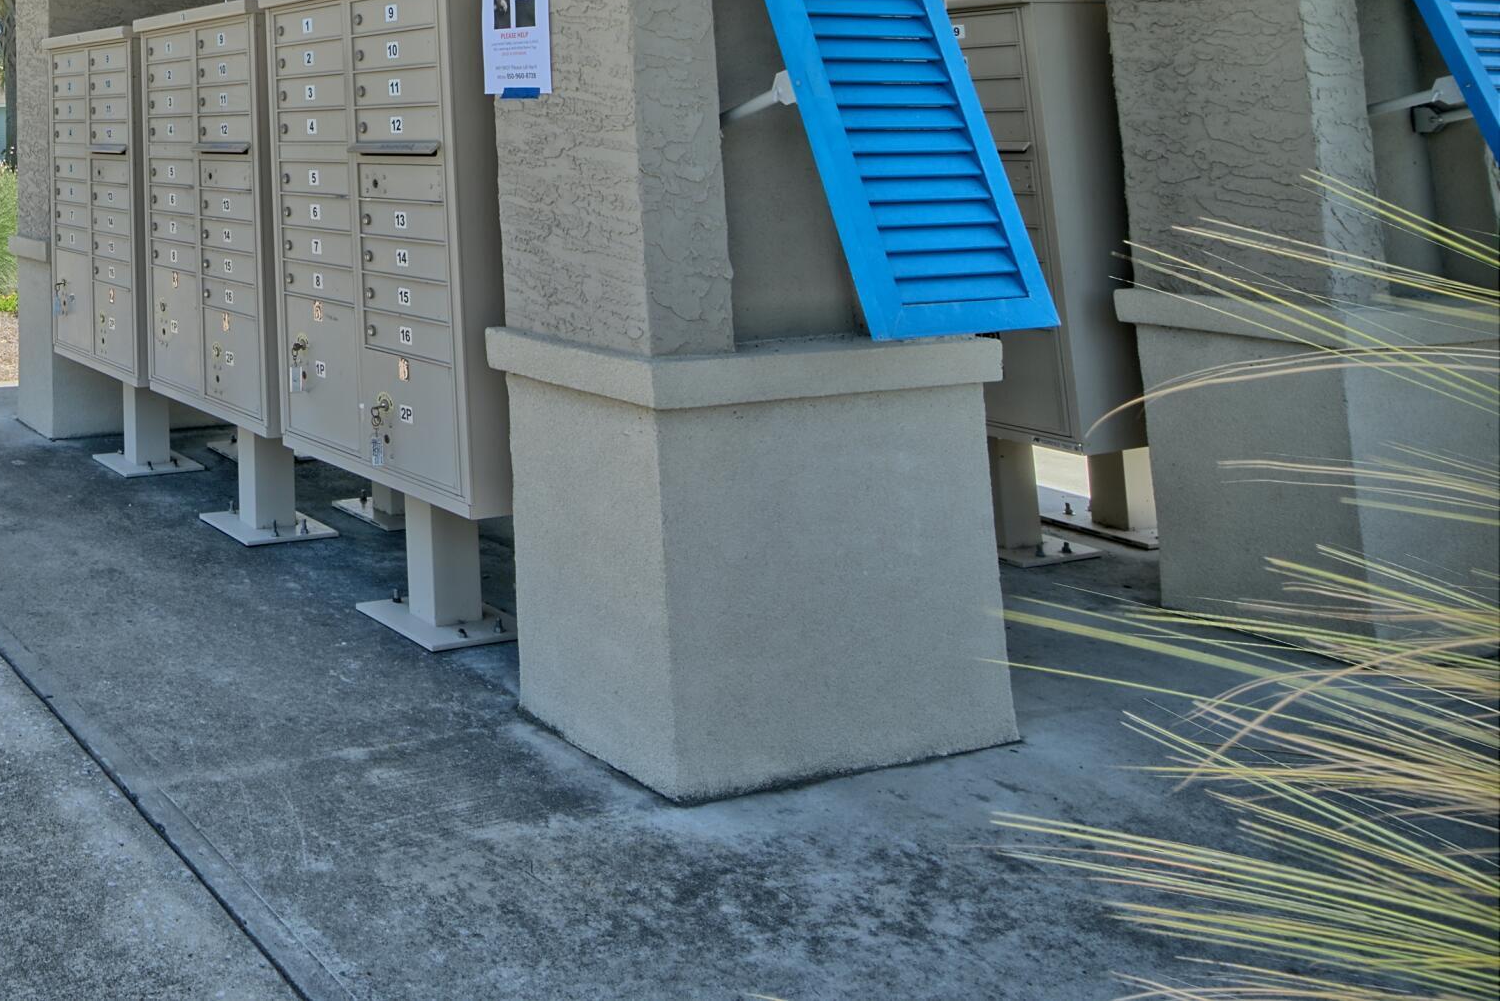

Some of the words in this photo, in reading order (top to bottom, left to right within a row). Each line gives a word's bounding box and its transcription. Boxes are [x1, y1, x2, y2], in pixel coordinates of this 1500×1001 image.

[388, 7, 394, 19] 9
[305, 21, 310, 31] 1
[953, 27, 960, 36] 9
[388, 44, 398, 57] 10
[306, 53, 312, 64] 2
[219, 64, 226, 74] 10
[308, 87, 313, 98] 3
[390, 82, 399, 93] 11
[220, 95, 227, 104] 11
[221, 125, 228, 135] 12
[309, 121, 315, 132] 4
[392, 119, 402, 131] 12
[311, 173, 316, 183] 5
[223, 200, 230, 210] 13
[312, 207, 318, 217] 6
[396, 214, 406, 226] 13
[223, 230, 230, 240] 14
[314, 241, 319, 252] 7
[397, 252, 407, 264] 14
[224, 261, 232, 271] 15
[315, 276, 321, 287] 8
[225, 291, 232, 302] 16
[399, 291, 409, 303] 15
[171, 322, 178, 331] 1P
[400, 329, 411, 342] 16
[226, 353, 234, 363] 2P
[316, 363, 325, 374] 1P
[401, 407, 412, 420] 2P
